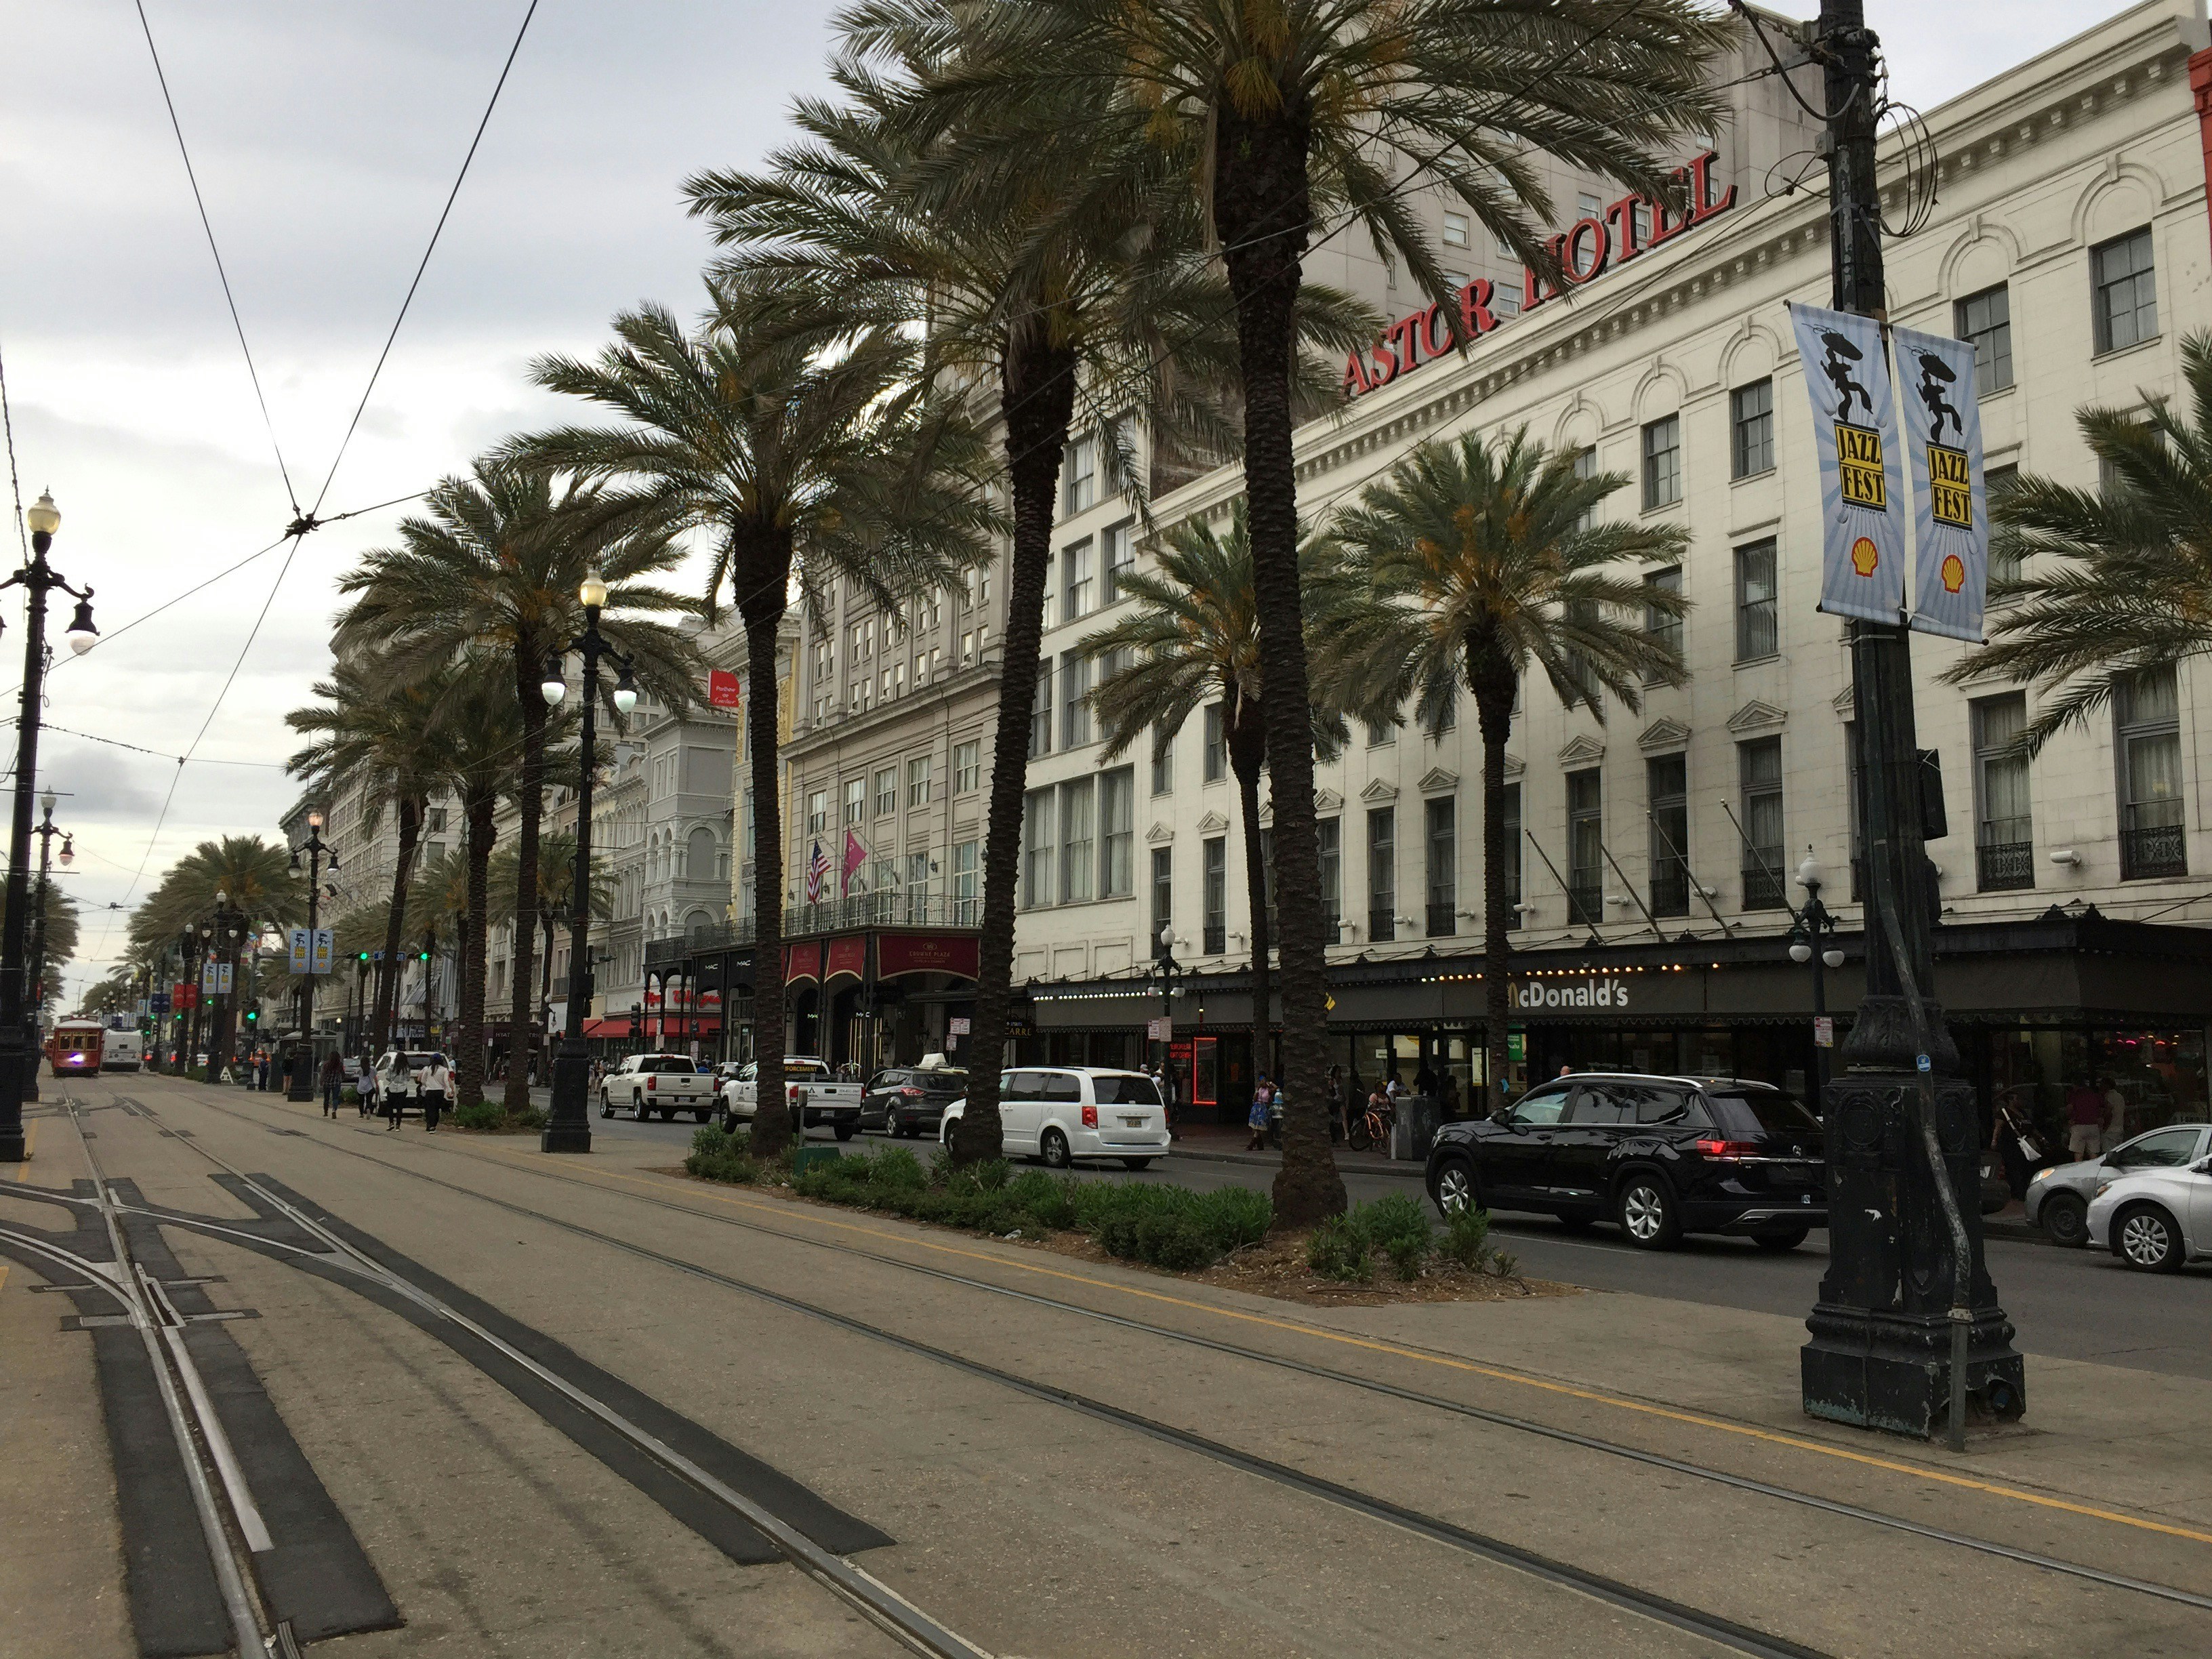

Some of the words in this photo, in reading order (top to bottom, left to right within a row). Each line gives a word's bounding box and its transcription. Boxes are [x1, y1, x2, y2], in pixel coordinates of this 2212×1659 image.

[1343, 278, 1499, 395] ASTOR
[1521, 150, 1737, 312] HOTEL
[1838, 428, 1881, 464] JAZZ
[1841, 466, 1883, 503] FEST
[1930, 450, 1968, 485] JAZZ
[1933, 486, 1970, 523] FEST
[378, 951, 405, 961] Boon
